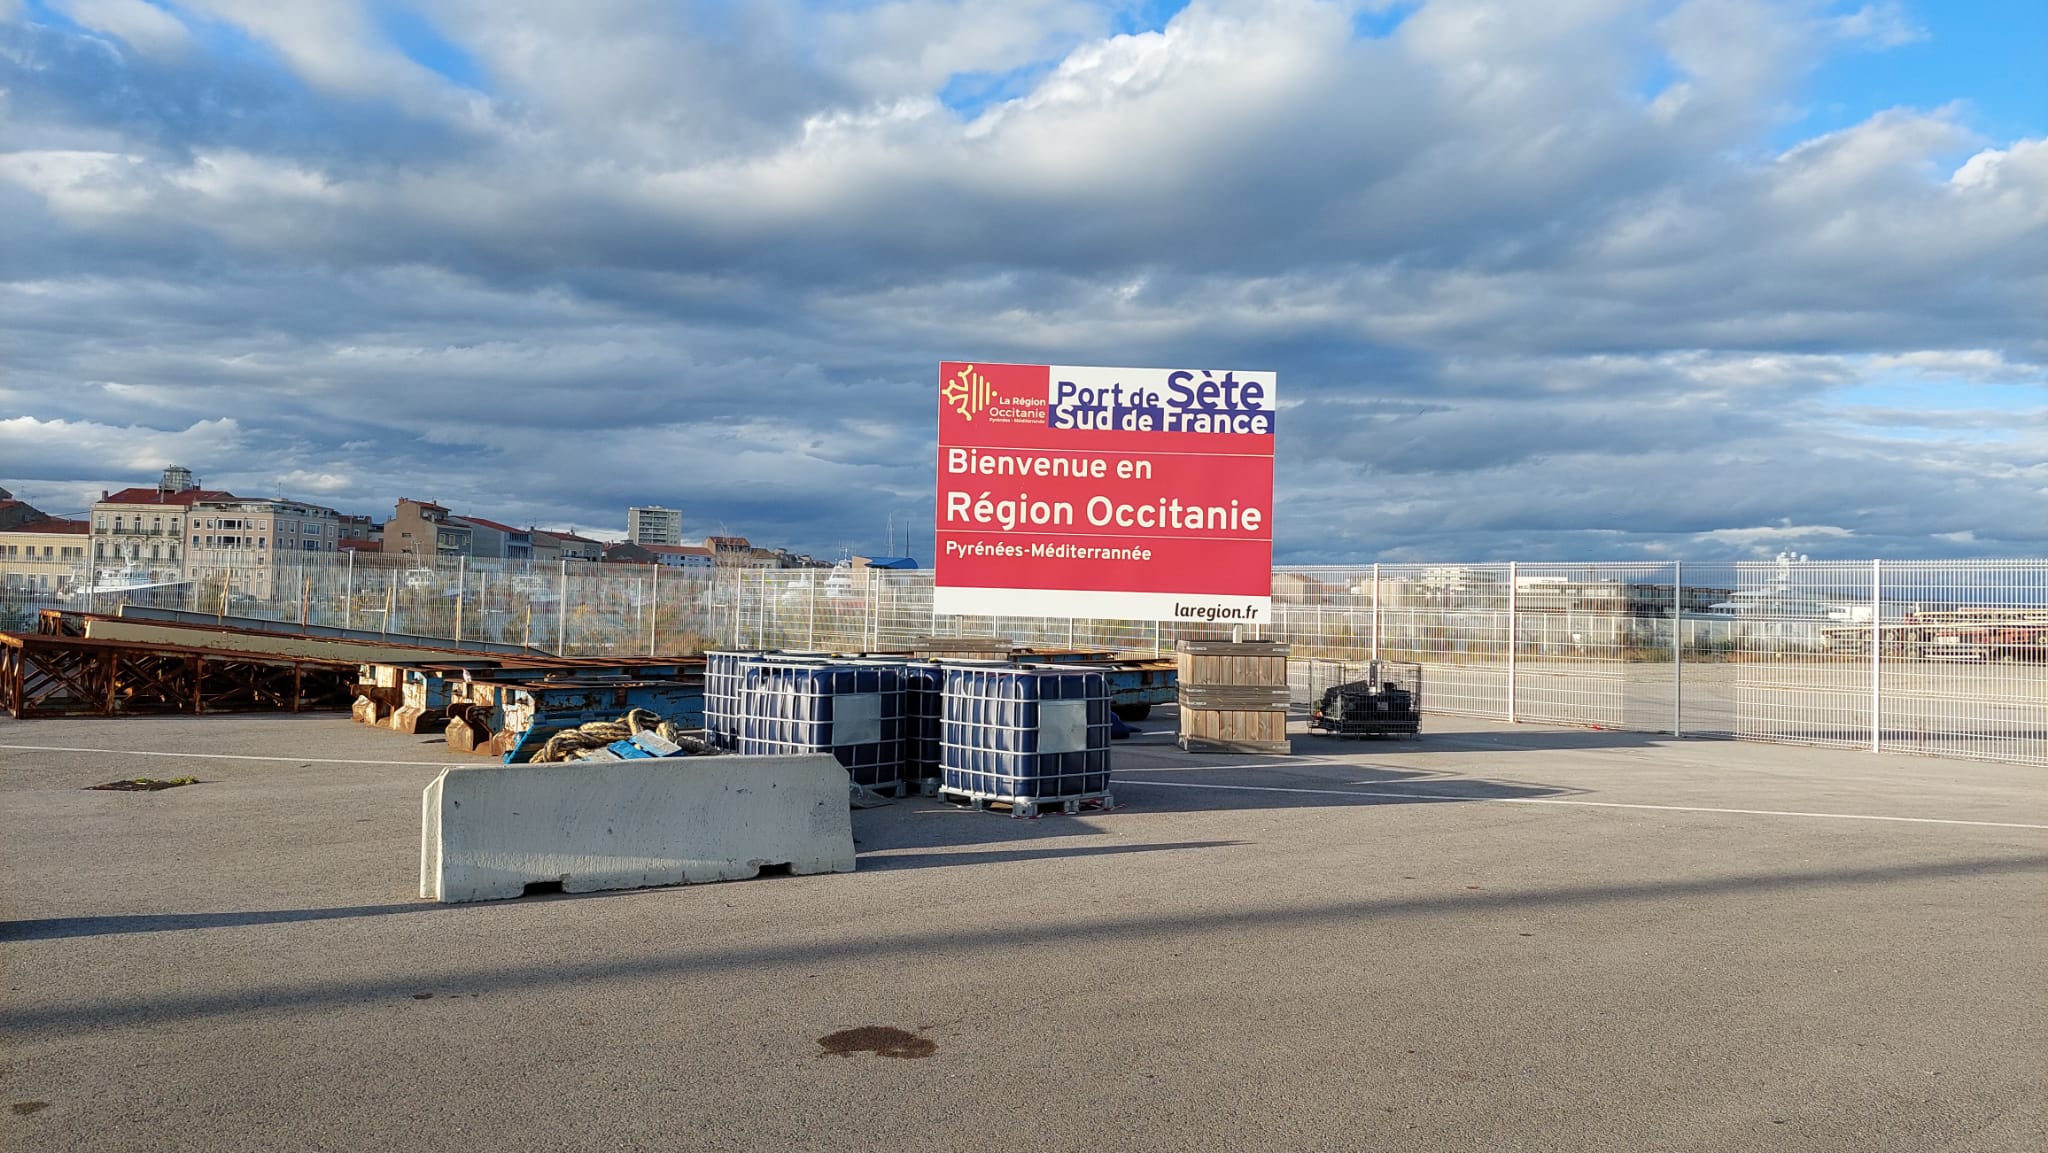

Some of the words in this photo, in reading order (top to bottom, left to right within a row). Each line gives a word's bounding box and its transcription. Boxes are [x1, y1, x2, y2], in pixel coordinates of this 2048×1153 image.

[1000, 396, 1010, 405] La
[1012, 396, 1046, 408] Région
[1058, 381, 1123, 407] Port
[1130, 387, 1159, 408] de
[1166, 370, 1264, 410] Sète
[989, 407, 1046, 419] Occitanie
[1055, 404, 1113, 431] Sud
[1122, 409, 1153, 432] de
[1163, 408, 1268, 435] France
[948, 448, 1107, 478] Bienvenue
[1116, 459, 1152, 479] en
[947, 491, 1073, 531] Région
[1086, 495, 1262, 531] Occitanie
[946, 540, 1152, 561] Pyrénées-Méditerrannée
[1174, 602, 1259, 621] laregion.fr
